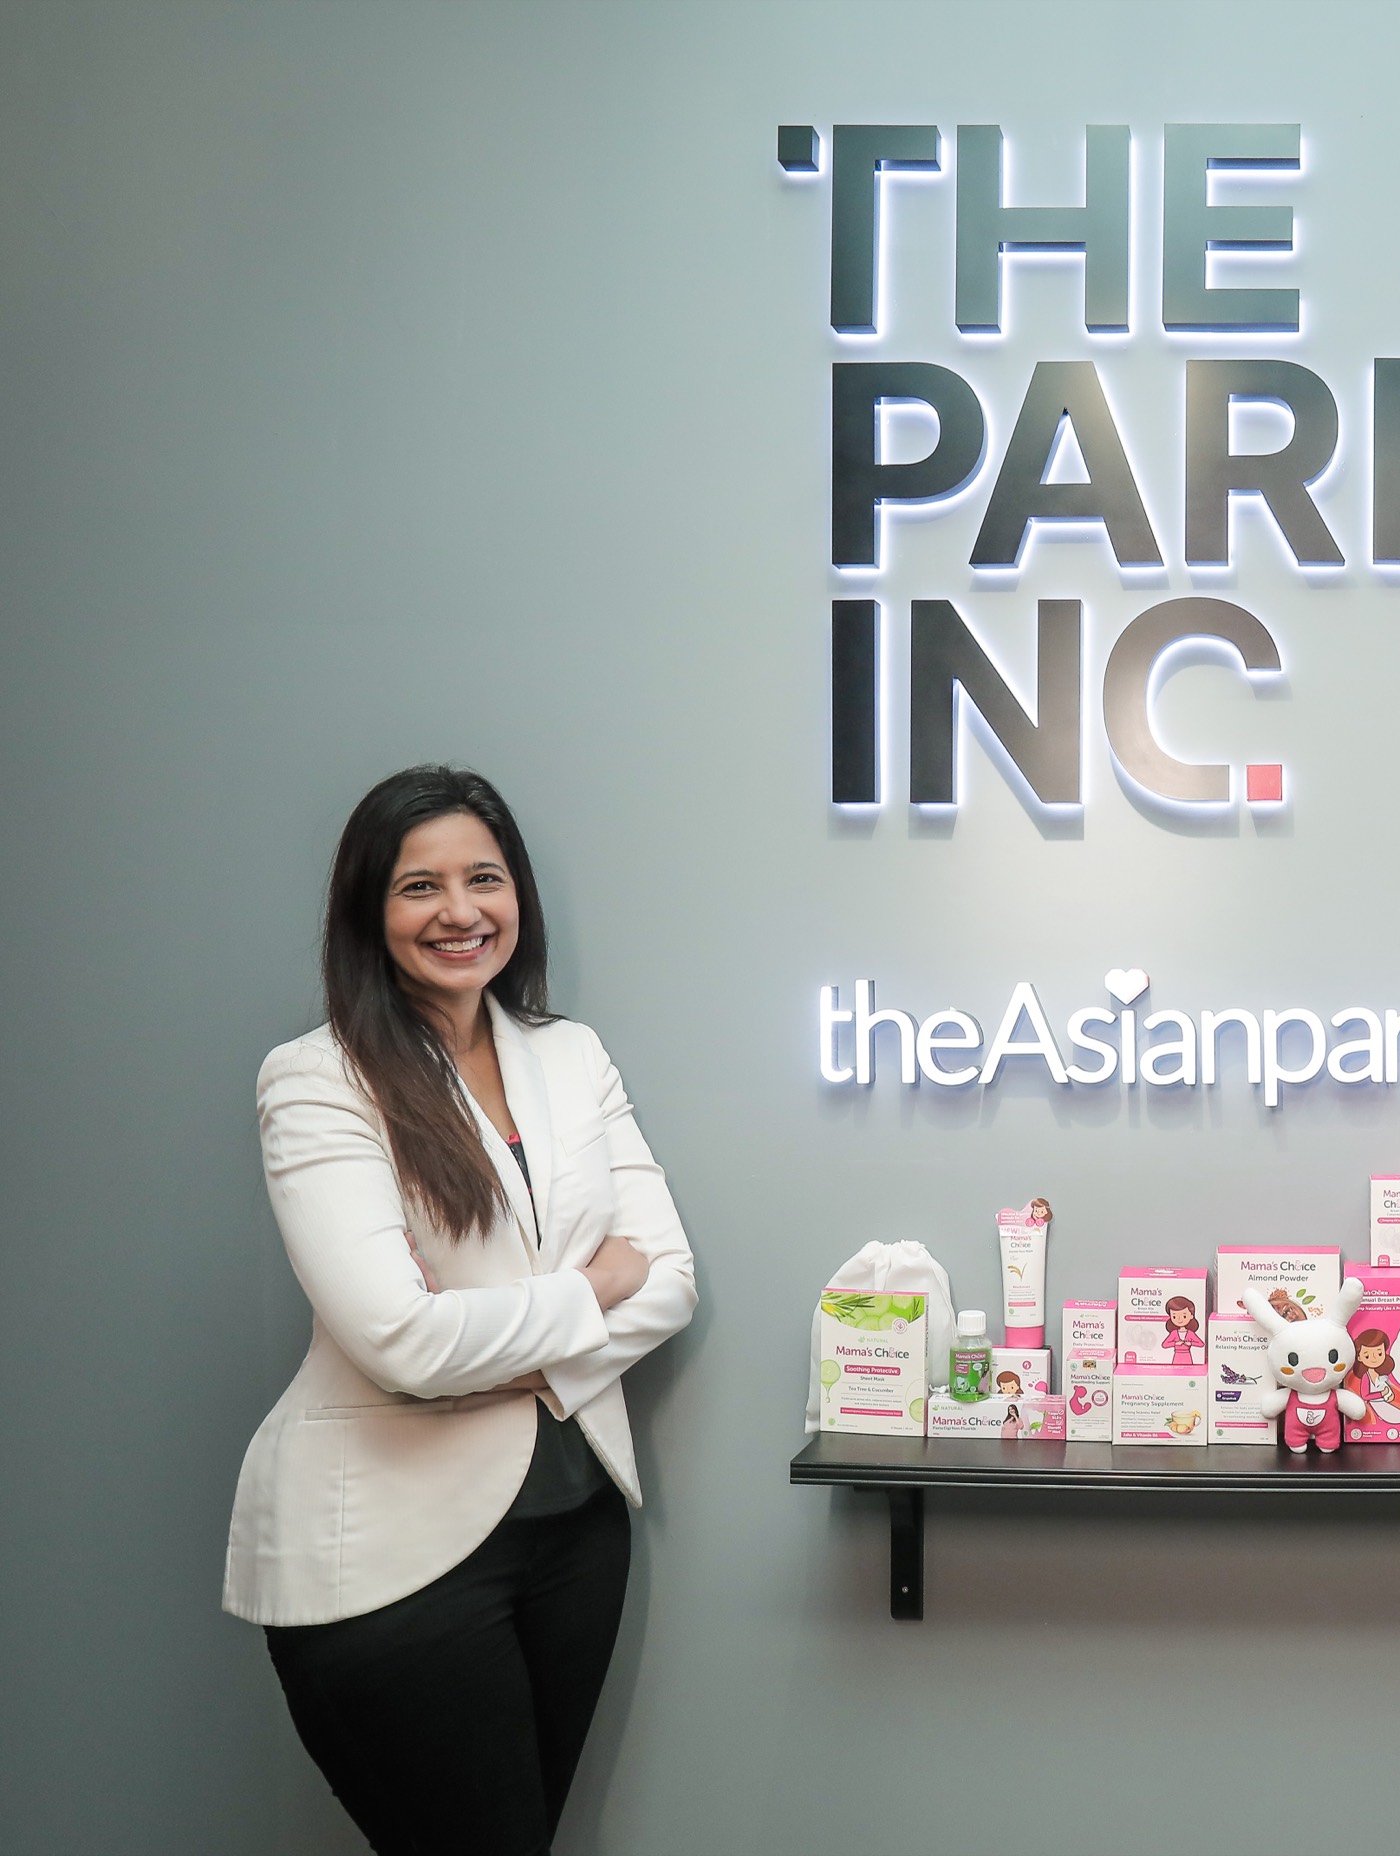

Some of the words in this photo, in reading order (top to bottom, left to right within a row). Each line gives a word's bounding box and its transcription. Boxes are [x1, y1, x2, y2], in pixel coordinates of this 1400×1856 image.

[778, 124, 1303, 333] THE
[831, 596, 1283, 804] INC.
[1240, 1260, 1278, 1270] Mama's
[1280, 1260, 1316, 1271] Choice
[1130, 1287, 1162, 1296] Mama's
[1072, 1320, 1105, 1329] Mama's
[835, 1345, 873, 1357] Mama's
[874, 1346, 909, 1359] Choice
[845, 1365, 870, 1373] Soothing
[932, 1416, 967, 1426] Mama's
[968, 1415, 1002, 1426] Choice
